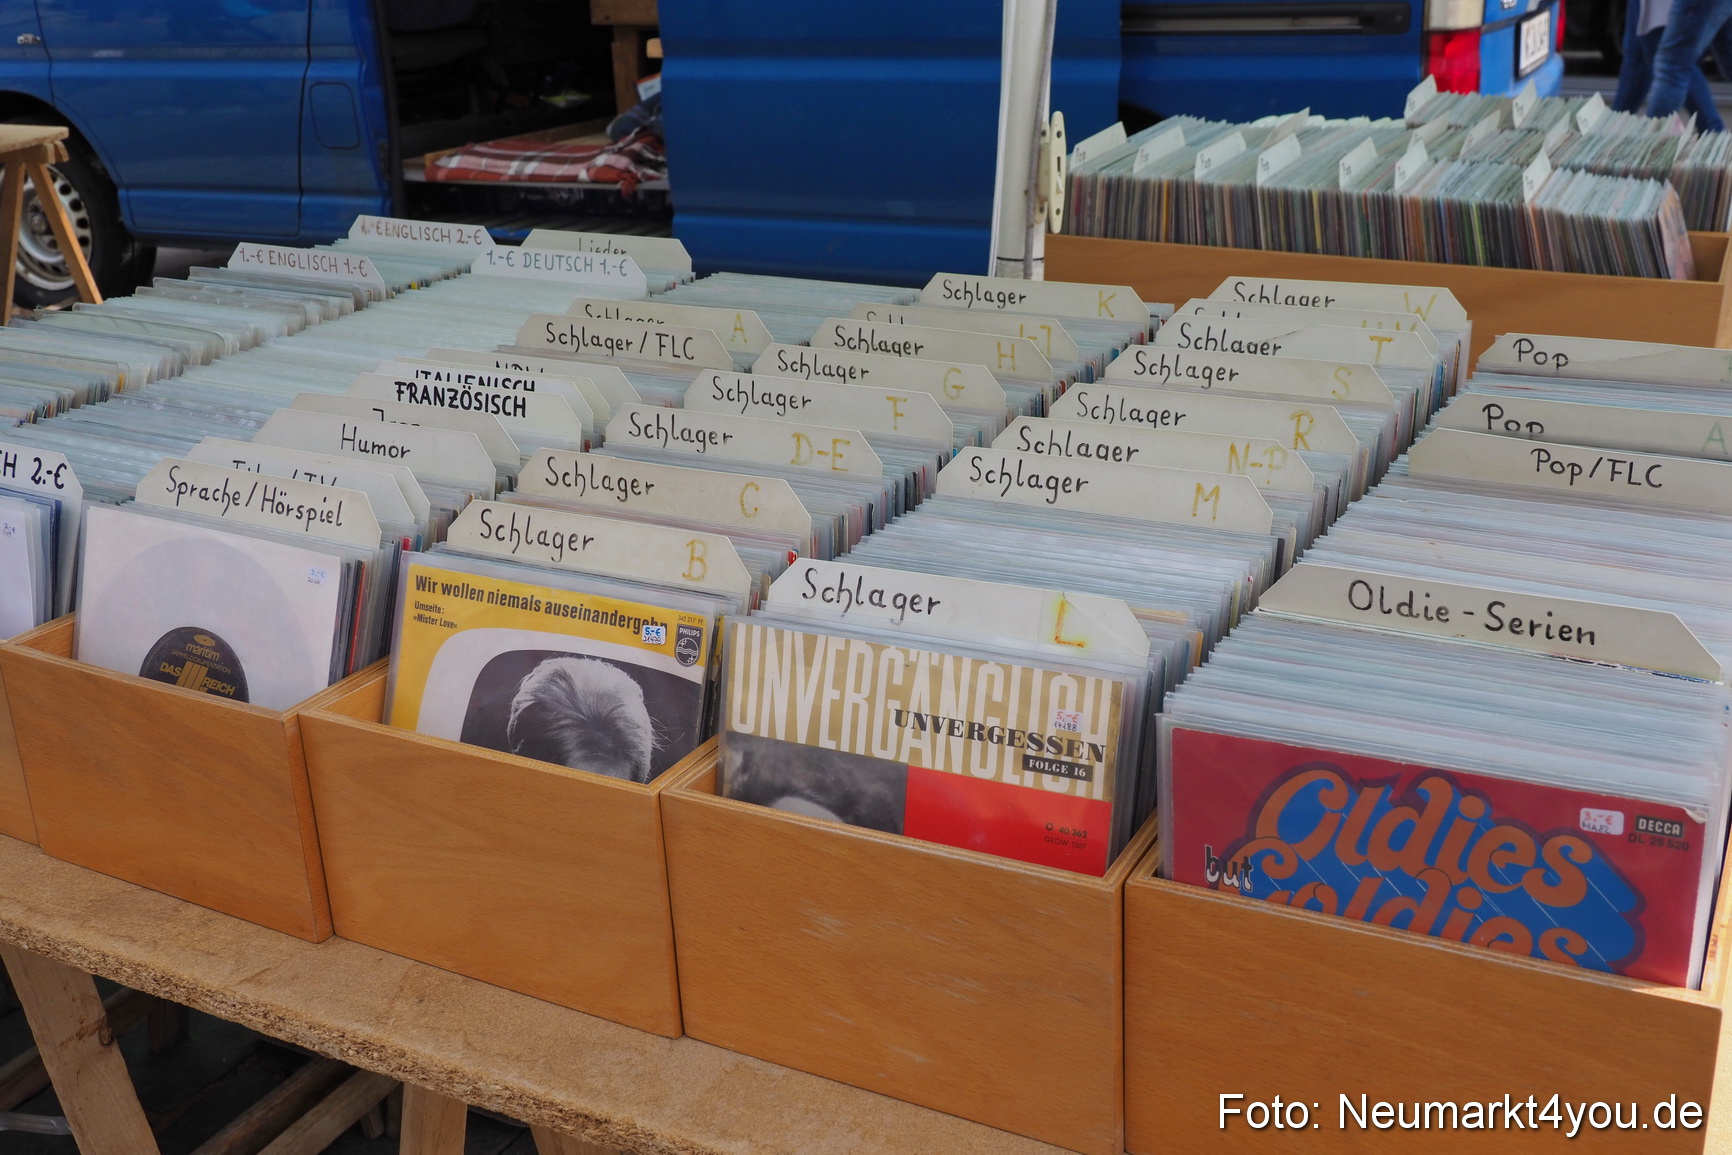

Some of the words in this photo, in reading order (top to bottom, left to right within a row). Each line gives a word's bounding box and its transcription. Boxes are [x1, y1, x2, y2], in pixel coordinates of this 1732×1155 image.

[385, 225, 451, 243] ENGLISCH
[269, 250, 338, 274] ENGLISCH
[522, 252, 593, 273] DEUTSCH
[942, 279, 1027, 308] Schlager
[1097, 290, 1118, 318] K
[731, 312, 748, 344] A
[834, 325, 925, 357] Schlager
[996, 341, 1017, 371] H
[1368, 335, 1395, 364] T
[1513, 338, 1569, 373] Pop
[777, 350, 870, 384] Schlager
[942, 367, 965, 401] G
[1134, 350, 1240, 390] Schlager
[1330, 366, 1353, 400] S
[394, 381, 527, 418] FRANZÖSISCH
[712, 375, 812, 417] Schlager
[886, 395, 909, 431] F
[628, 411, 734, 455] Schlager
[1076, 391, 1187, 428] Schlager
[1288, 408, 1315, 452] R
[340, 423, 411, 459] Humor
[1017, 425, 1140, 464] Schlager
[545, 456, 656, 503] Schlager
[738, 481, 761, 519] C
[969, 456, 1090, 505] Schlager
[1192, 481, 1221, 522] M
[479, 508, 595, 563] Schlager
[682, 538, 708, 582] B
[414, 600, 445, 615] Umseite:
[415, 574, 438, 594] Wir
[441, 582, 485, 603] wollen
[486, 588, 542, 613] niemals
[801, 567, 942, 625] Schlager
[1053, 598, 1087, 649] L
[679, 627, 701, 638] PHILIPS
[185, 642, 221, 661] maritim
[159, 661, 183, 677] DAS
[201, 676, 237, 696] REICH
[893, 708, 1106, 764] UNVERGESSEN
[1028, 759, 1069, 775] FOLGE
[1073, 766, 1087, 778] 16
[1058, 826, 1070, 836] 40
[1071, 828, 1088, 839] 362
[1627, 833, 1646, 845] DL
[1666, 839, 1690, 852] 520
[1637, 818, 1681, 836] DECCA
[1203, 843, 1255, 893] but
